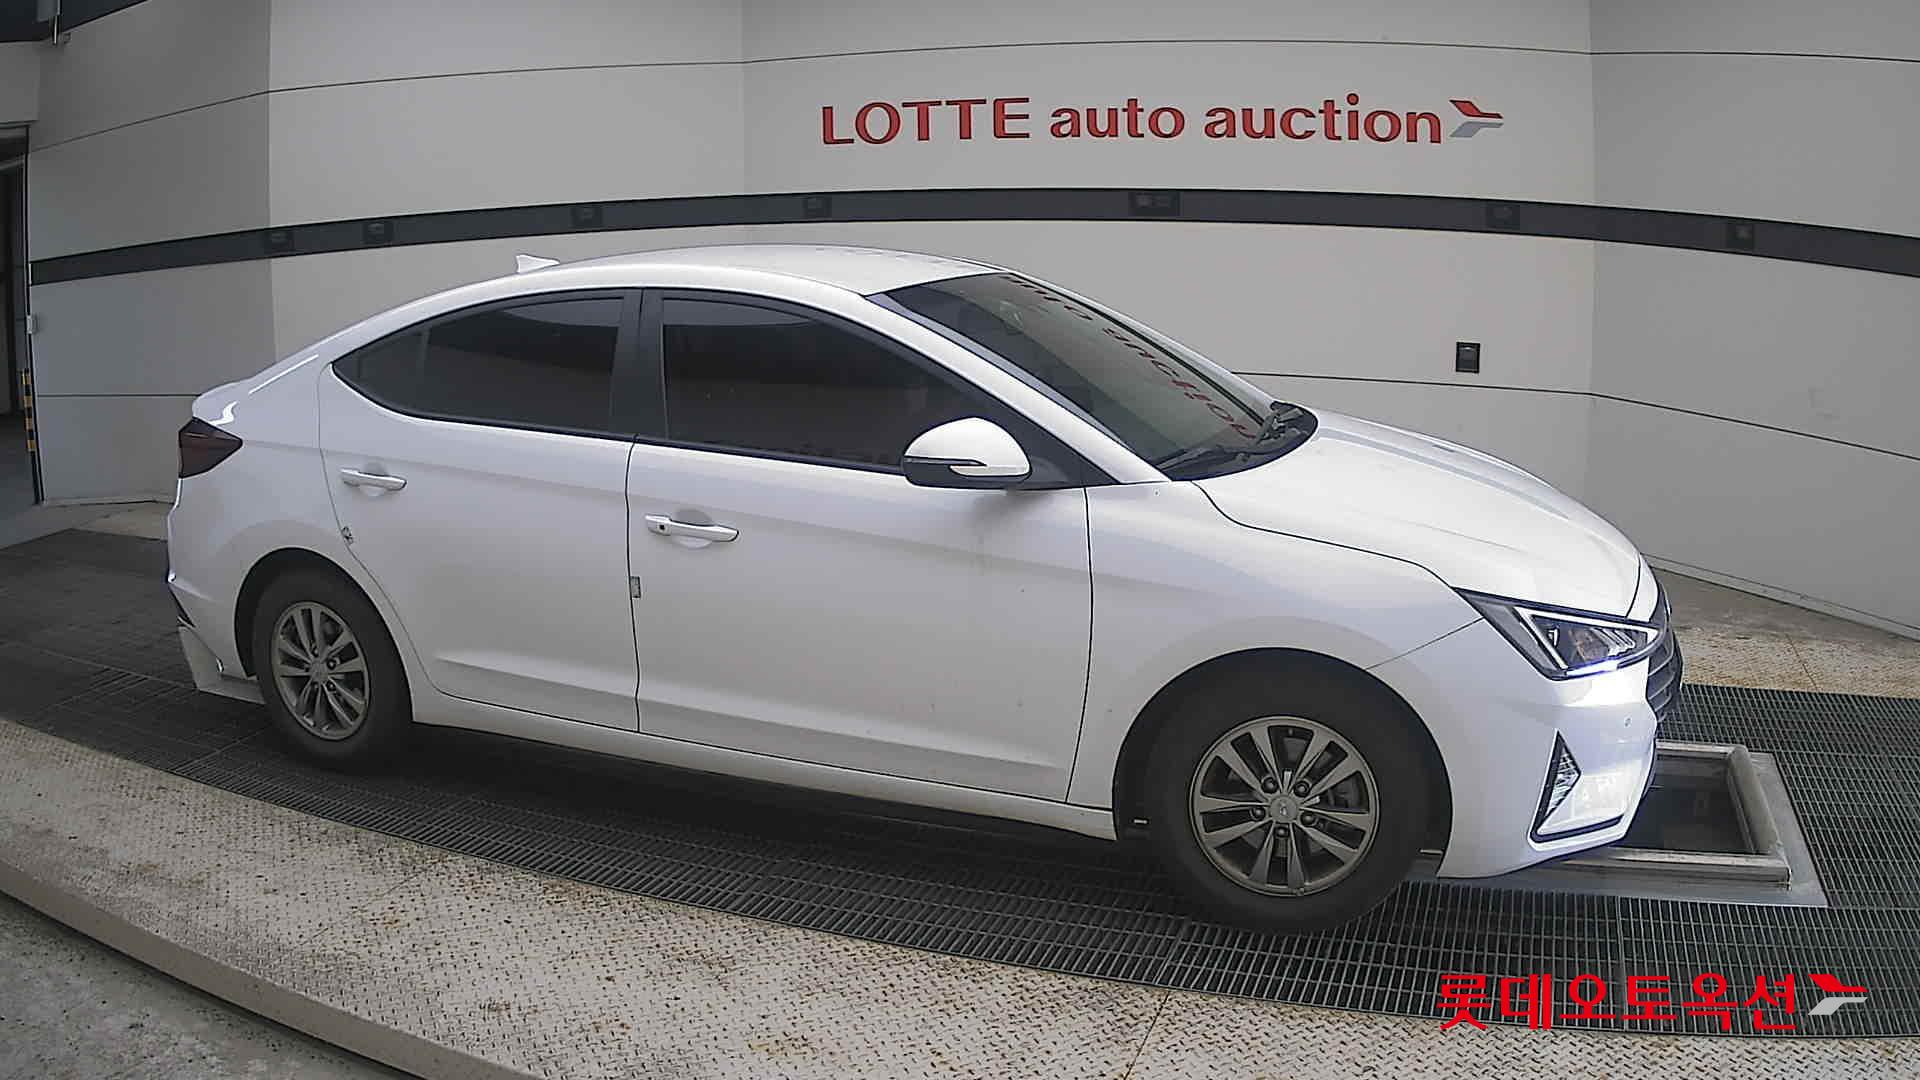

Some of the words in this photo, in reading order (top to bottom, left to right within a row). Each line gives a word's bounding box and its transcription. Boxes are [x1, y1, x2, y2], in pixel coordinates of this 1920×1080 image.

[822, 97, 1030, 144] LOTTE
[1050, 98, 1185, 138] auto
[1203, 94, 1442, 144] auction
